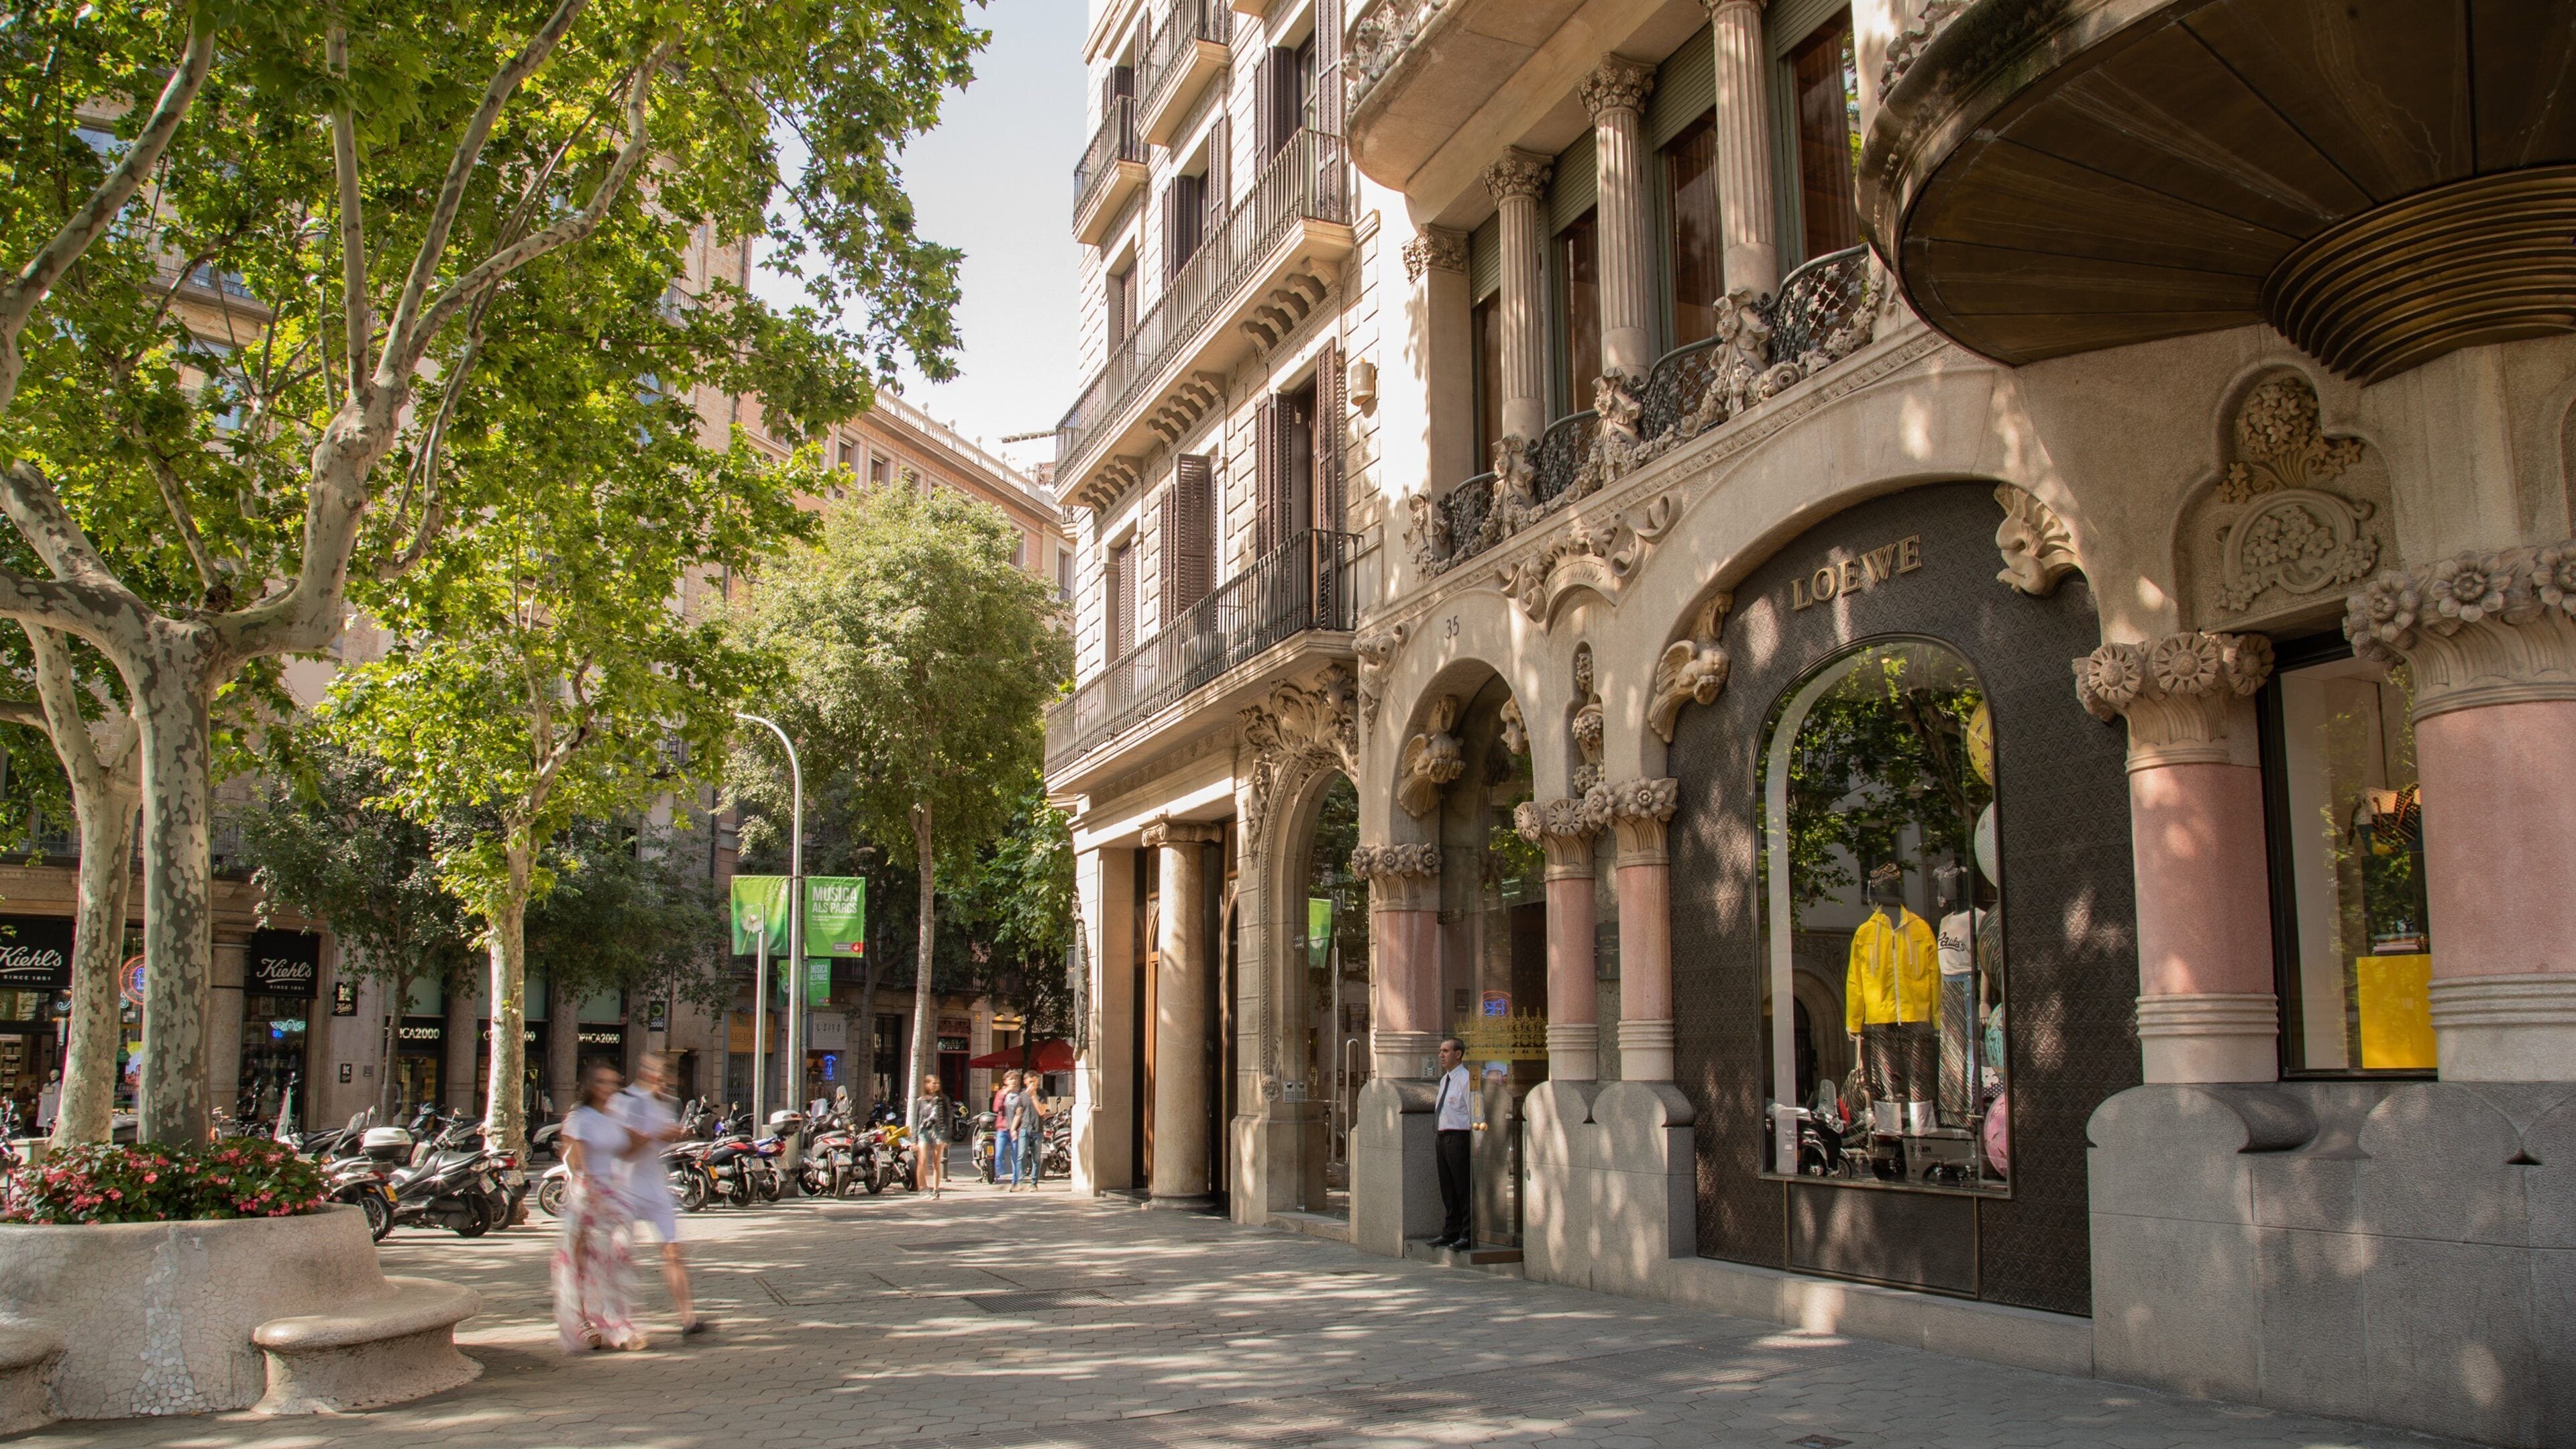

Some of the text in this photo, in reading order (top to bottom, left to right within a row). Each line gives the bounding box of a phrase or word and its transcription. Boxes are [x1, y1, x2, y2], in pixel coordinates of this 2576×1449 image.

[1790, 534, 1923, 611] LOEWE
[1445, 614, 1460, 640] 35
[812, 883, 858, 902] MÚSICA
[812, 902, 857, 914] ALS PARCS
[0, 946, 62, 967] Kiehl's
[256, 958, 312, 977] Kiehl's
